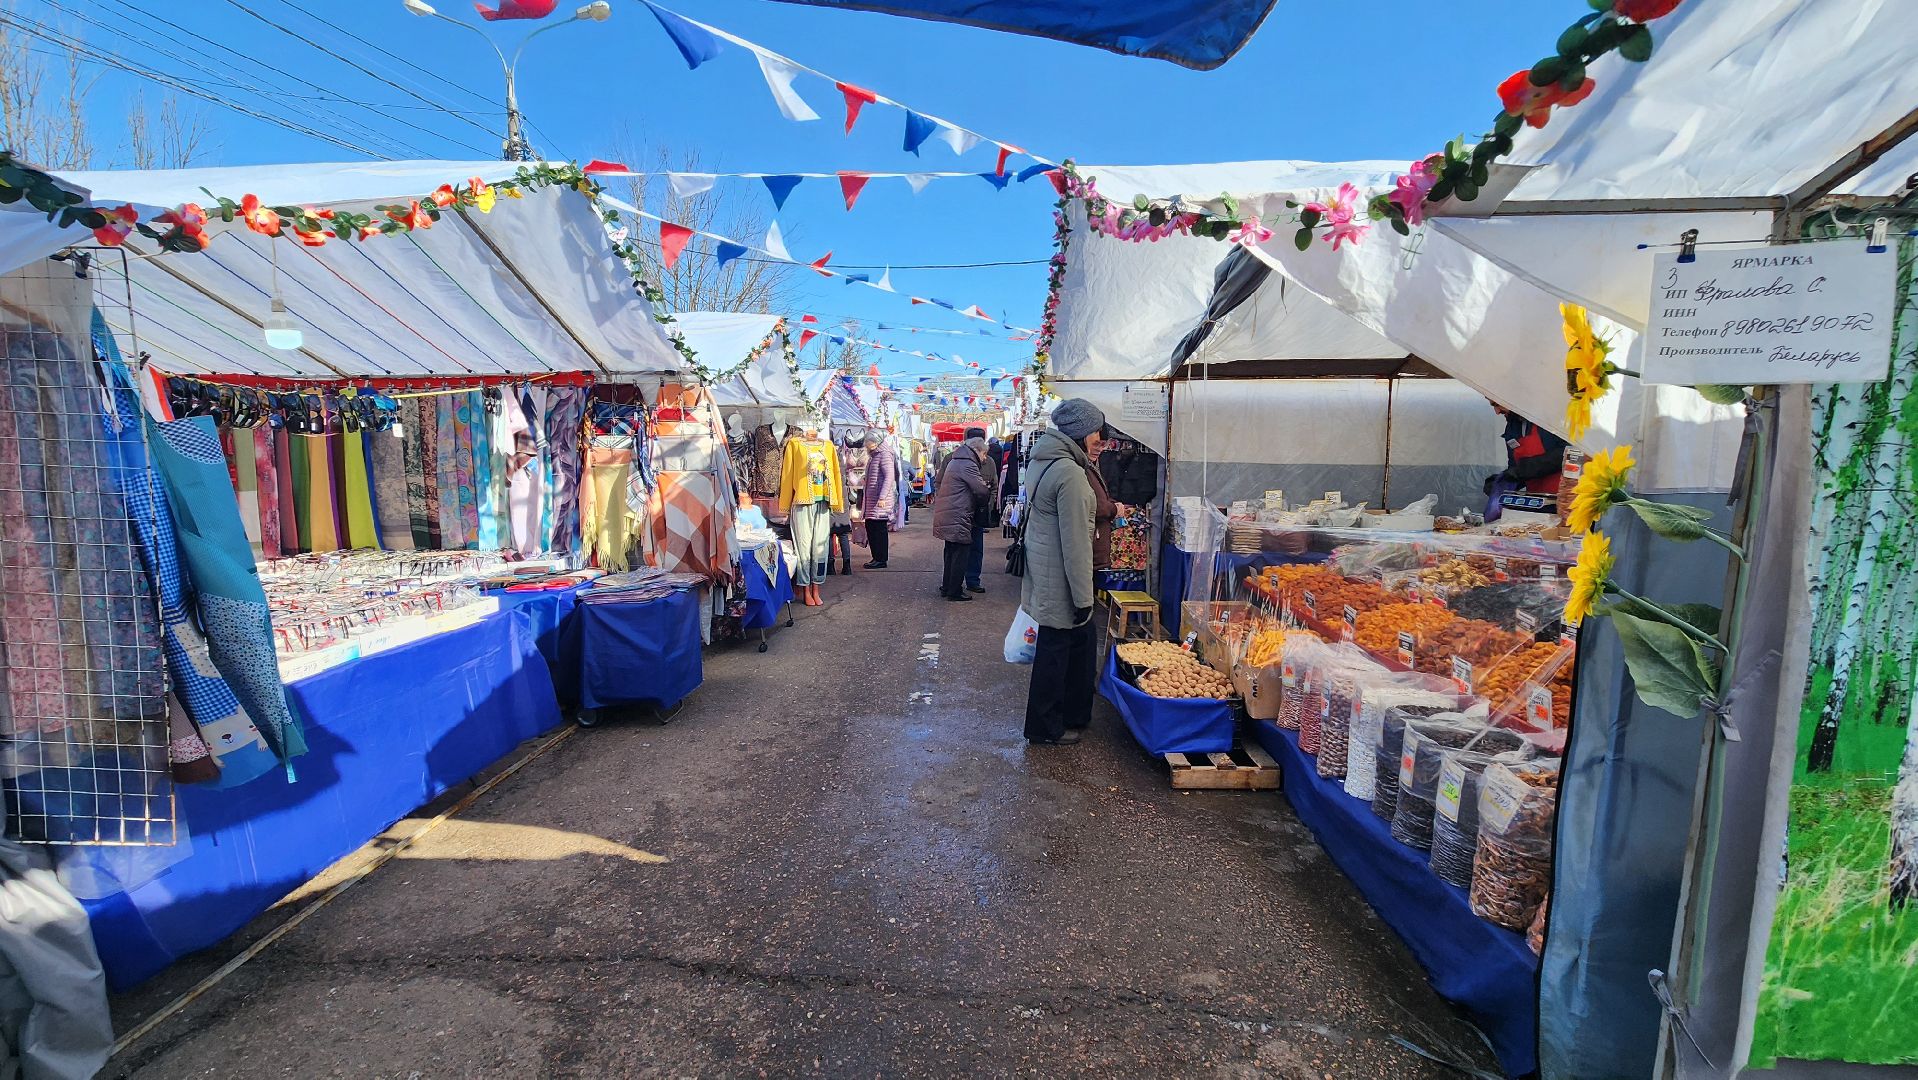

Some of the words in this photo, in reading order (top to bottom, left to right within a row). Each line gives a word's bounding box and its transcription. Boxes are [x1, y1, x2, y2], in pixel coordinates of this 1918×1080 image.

[1731, 256, 1814, 269] ЯРМАРКА
[1664, 289, 1688, 299] ИП
[1662, 308, 1698, 318] ИНН
[1661, 327, 1718, 339] Телефон
[1659, 345, 1764, 358] Производитель
[1768, 345, 1861, 370] Беларусь
